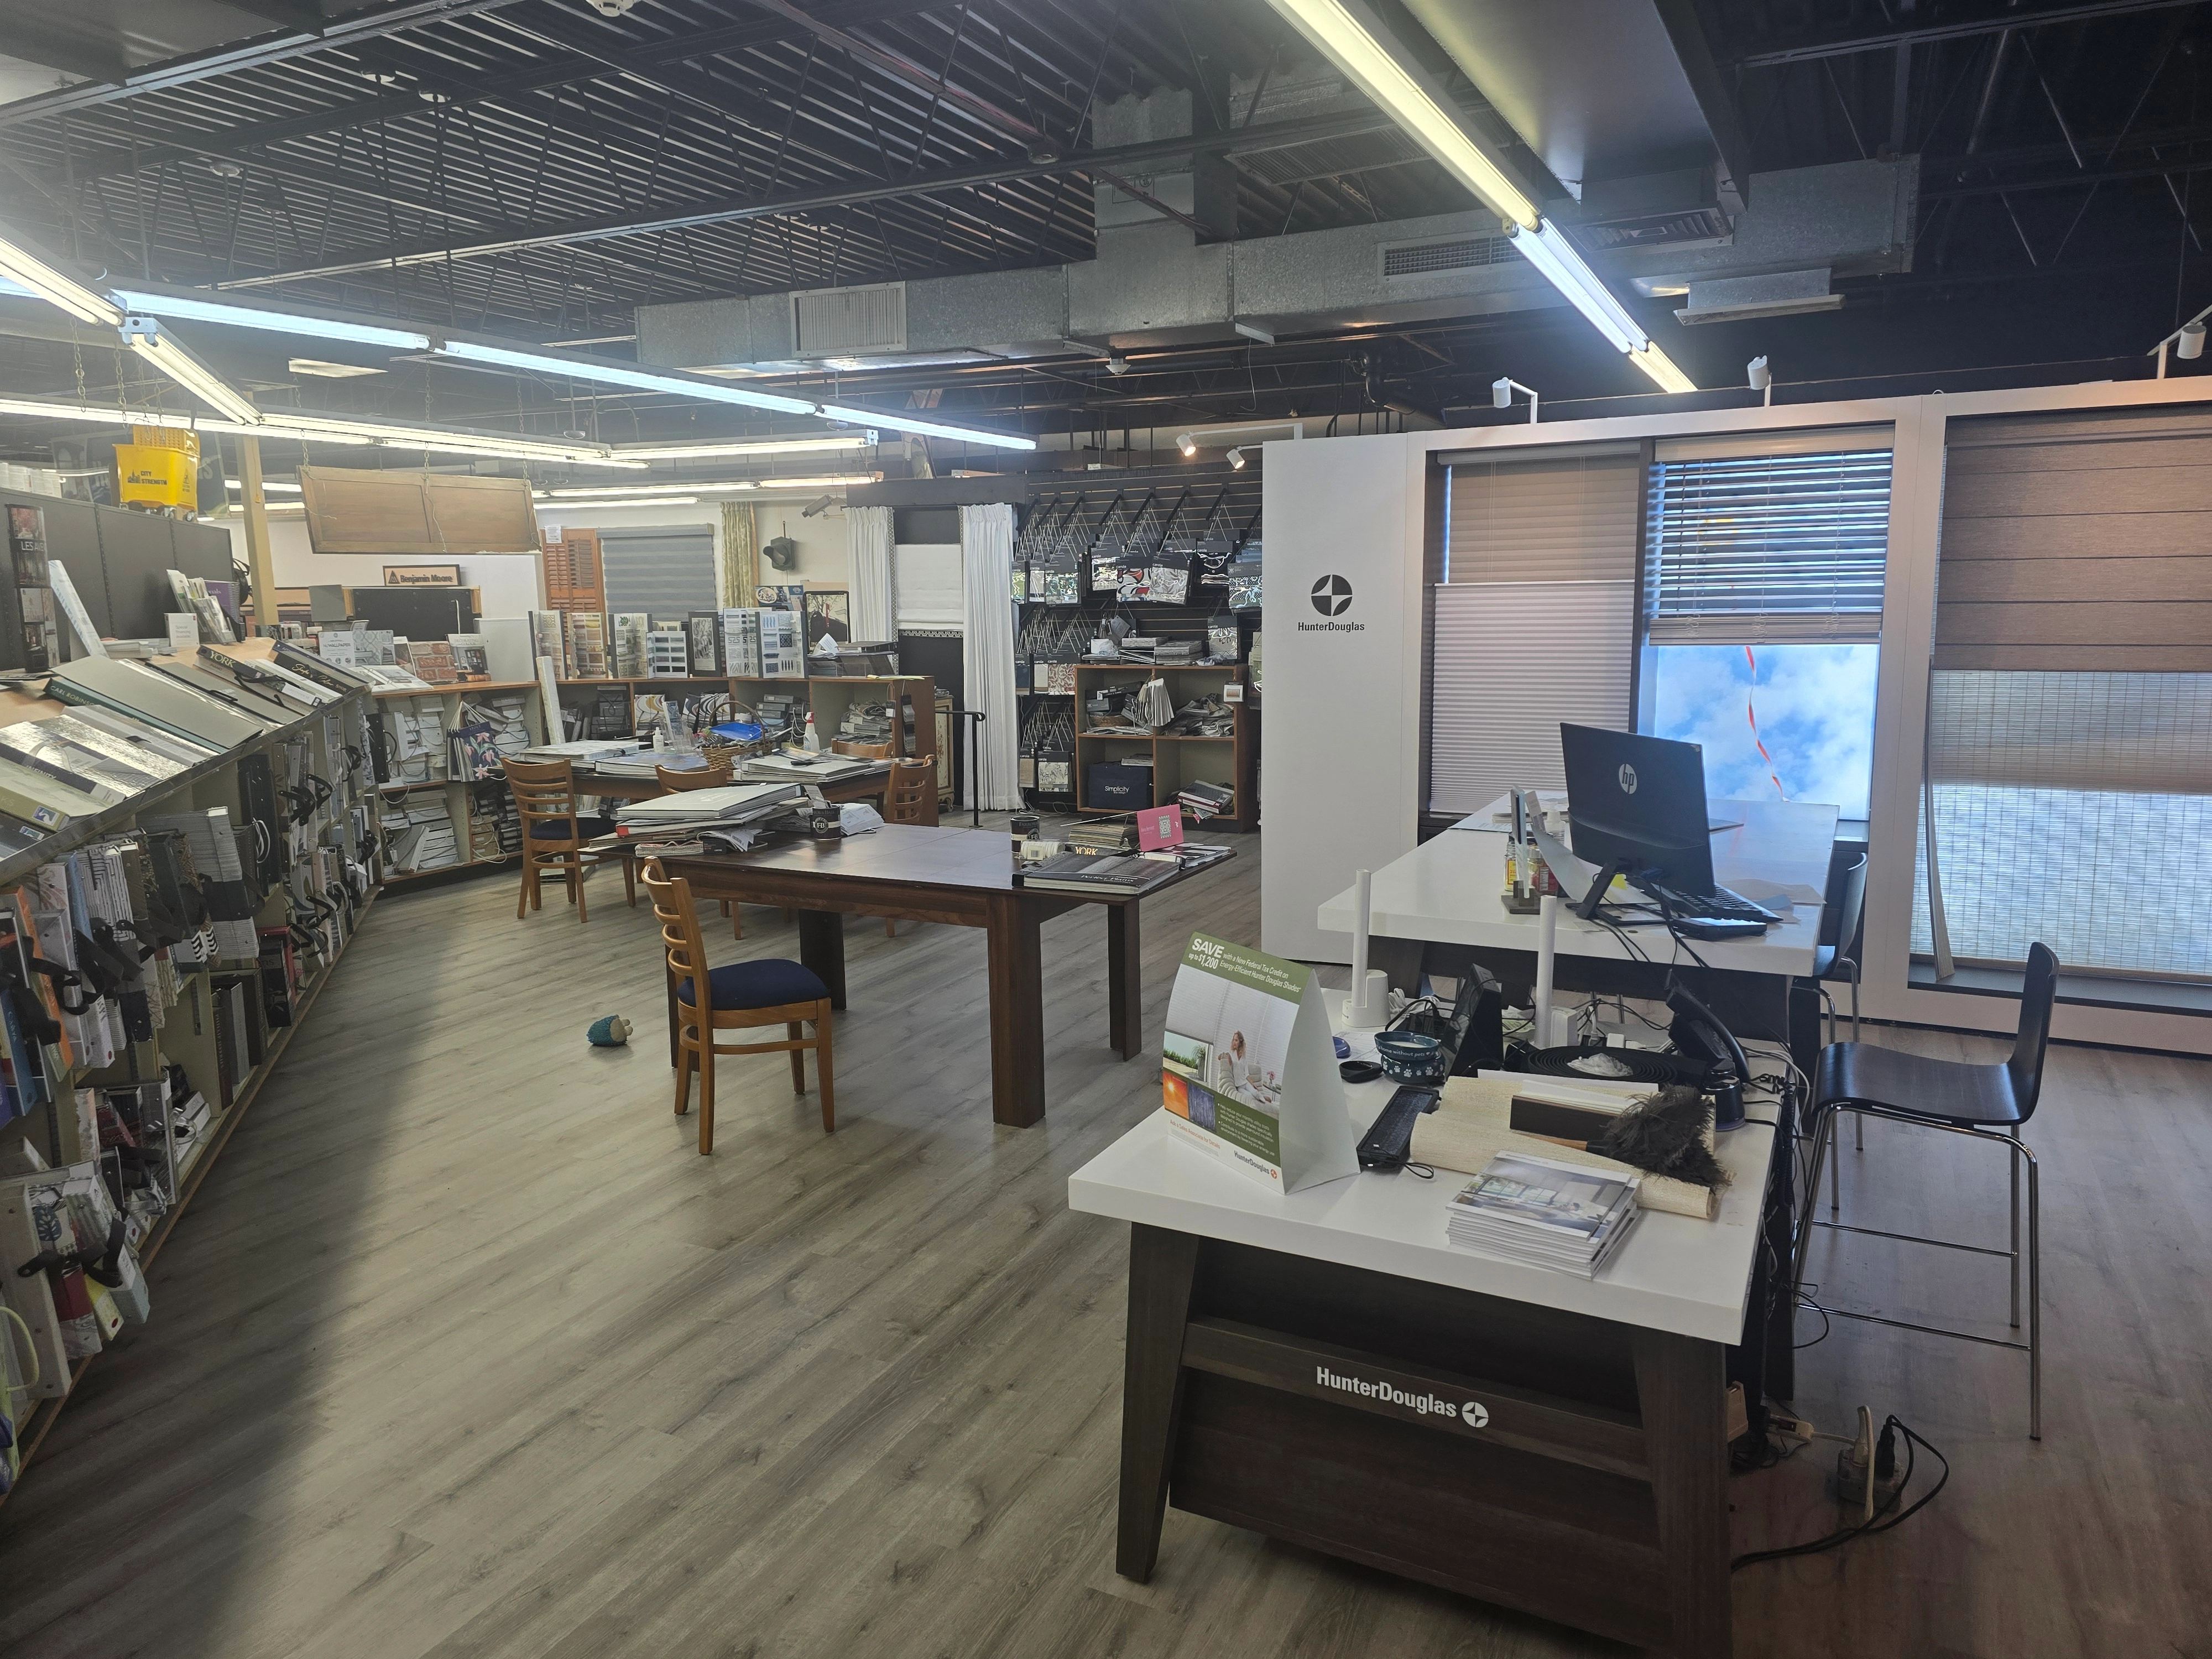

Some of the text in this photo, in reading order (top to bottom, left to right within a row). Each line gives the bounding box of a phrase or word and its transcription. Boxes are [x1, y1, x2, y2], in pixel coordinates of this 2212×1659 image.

[20, 541, 33, 551] LES
[400, 573, 453, 585] Benjamin Moore
[1298, 622, 1365, 633] HunterDouglas
[210, 650, 237, 668] YORK
[50, 686, 95, 706] CARL ROBINSO
[26, 765, 57, 780] INFINITY
[1621, 763, 1635, 794] hp
[1075, 846, 1098, 855] YORK
[1192, 938, 1224, 958] SAVE
[1198, 954, 1219, 969] $1,200
[1236, 956, 1245, 964] New
[1246, 959, 1261, 969] Federal
[1269, 967, 1282, 977] Credit
[1220, 960, 1251, 977] Energy-Efficient
[1251, 971, 1266, 982] Hunter
[1266, 975, 1283, 988] Douglas
[1234, 1150, 1270, 1174] HunterDouglas
[1316, 1365, 1457, 1417] HunterDouglas
